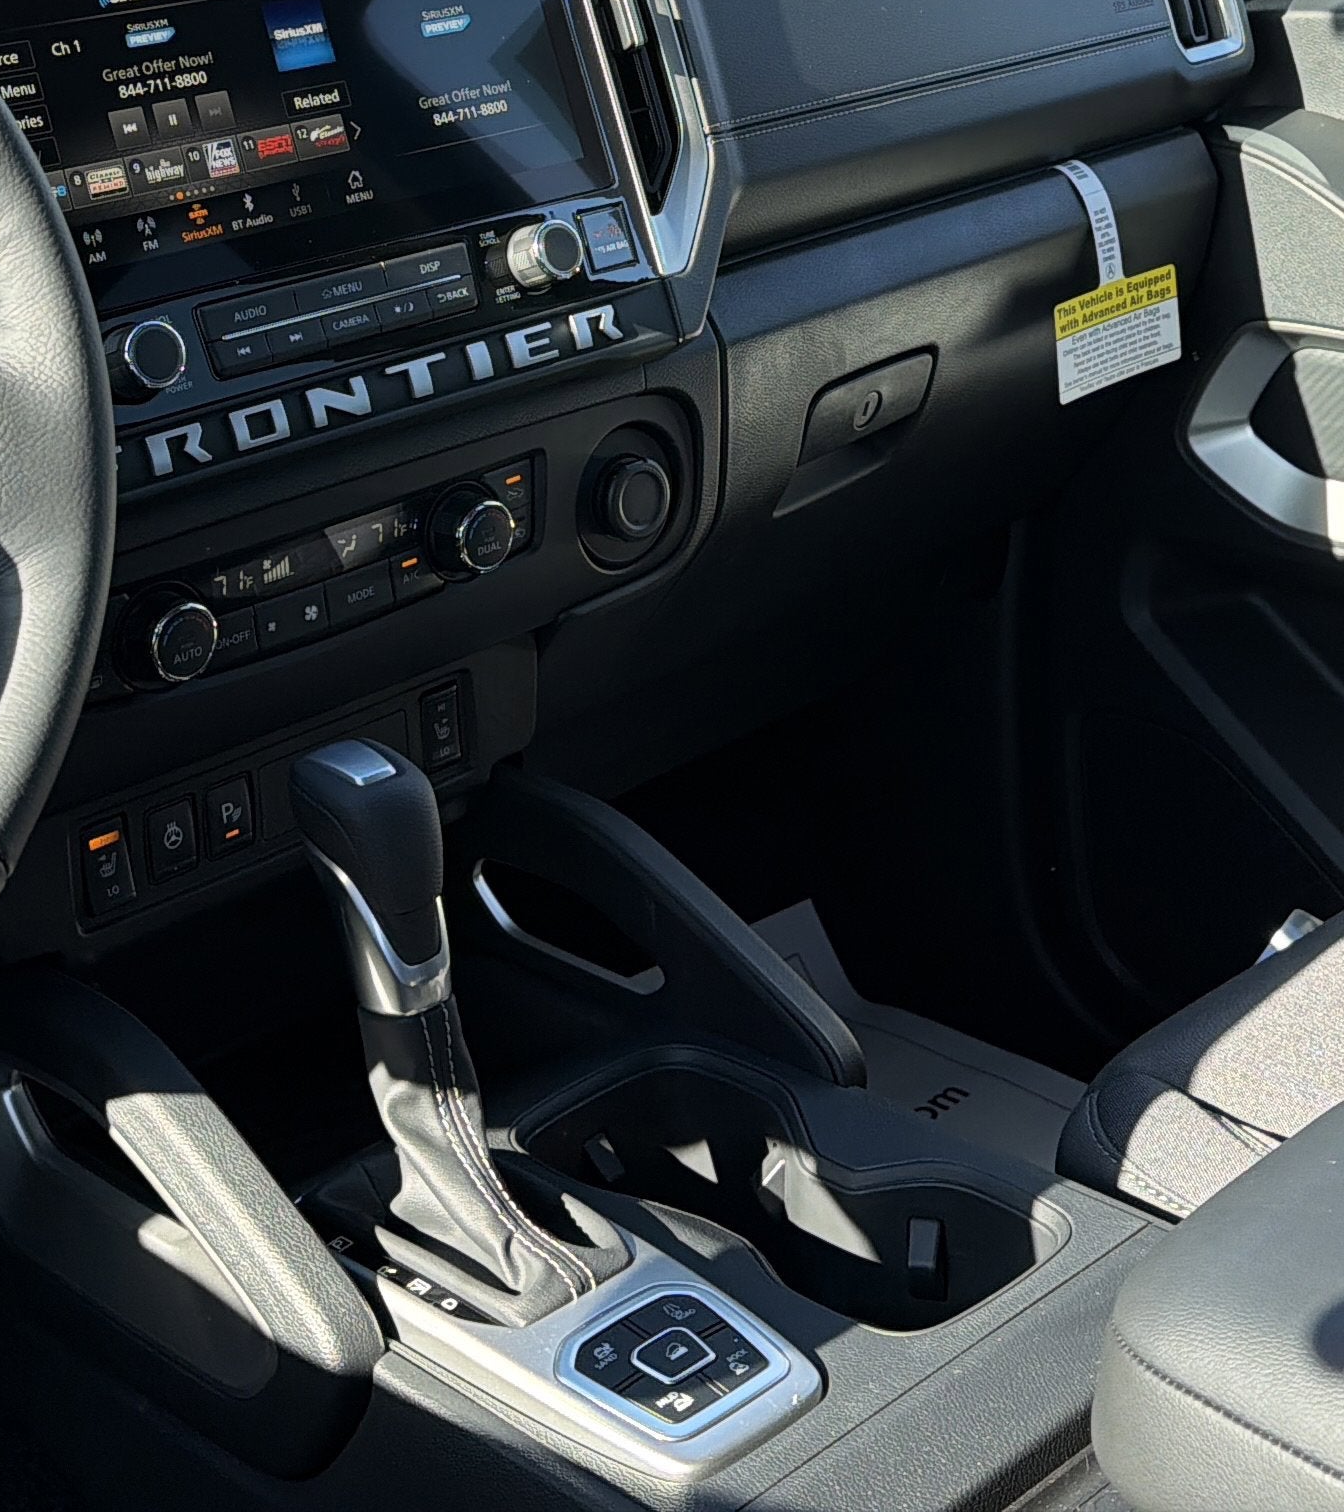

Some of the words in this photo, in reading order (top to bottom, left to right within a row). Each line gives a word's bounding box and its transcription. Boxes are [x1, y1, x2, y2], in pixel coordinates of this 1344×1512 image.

[273, 22, 324, 41] SiriusXM
[51, 42, 71, 57] Ch
[73, 40, 82, 53] 1
[102, 66, 141, 82] Great
[142, 58, 177, 75] Offer
[179, 51, 214, 69] Now!
[0, 82, 37, 100] Menu
[118, 71, 208, 99] 844-711-8800
[293, 88, 340, 111] Related
[418, 95, 451, 111] Great
[452, 87, 481, 103] Offer
[483, 80, 512, 96] Now!
[432, 99, 508, 127] 844-711-8800
[296, 129, 309, 140] 12
[215, 148, 233, 160] FOX
[243, 140, 255, 151] 11
[187, 150, 200, 161] 10
[212, 158, 237, 169] NEWS
[73, 174, 83, 186] 8
[145, 161, 184, 184] highway
[346, 189, 374, 205] MENU
[289, 203, 313, 218] USB1
[232, 219, 245, 232] BT
[246, 213, 274, 228] Audio
[181, 223, 224, 243] SiriusXM
[142, 238, 160, 252] FM
[88, 251, 107, 265] AM
[419, 260, 441, 275] DISP
[332, 280, 363, 296] MENU
[445, 287, 470, 302] BACK
[1056, 304, 1077, 321] This
[1078, 291, 1114, 311] Vehicle
[1116, 286, 1125, 298] is
[1126, 269, 1172, 294] Equipped
[233, 304, 268, 323] AUDIO
[1059, 317, 1080, 334] with
[1081, 299, 1128, 326] Advanced
[1129, 294, 1145, 308] Air
[1146, 285, 1172, 302] Bags
[332, 313, 370, 332] CAMERA
[1071, 333, 1088, 346] Even
[1101, 317, 1133, 335] Advanced
[1143, 306, 1161, 319] Bags
[114, 303, 626, 477] RONTIER
[165, 380, 193, 395] POWER
[476, 540, 503, 557] DUAL
[346, 585, 376, 604] MODE
[214, 629, 251, 652] ON-OFF
[172, 645, 204, 666] AUTO
[107, 884, 120, 897] LO
[594, 1353, 618, 1371] SAND
